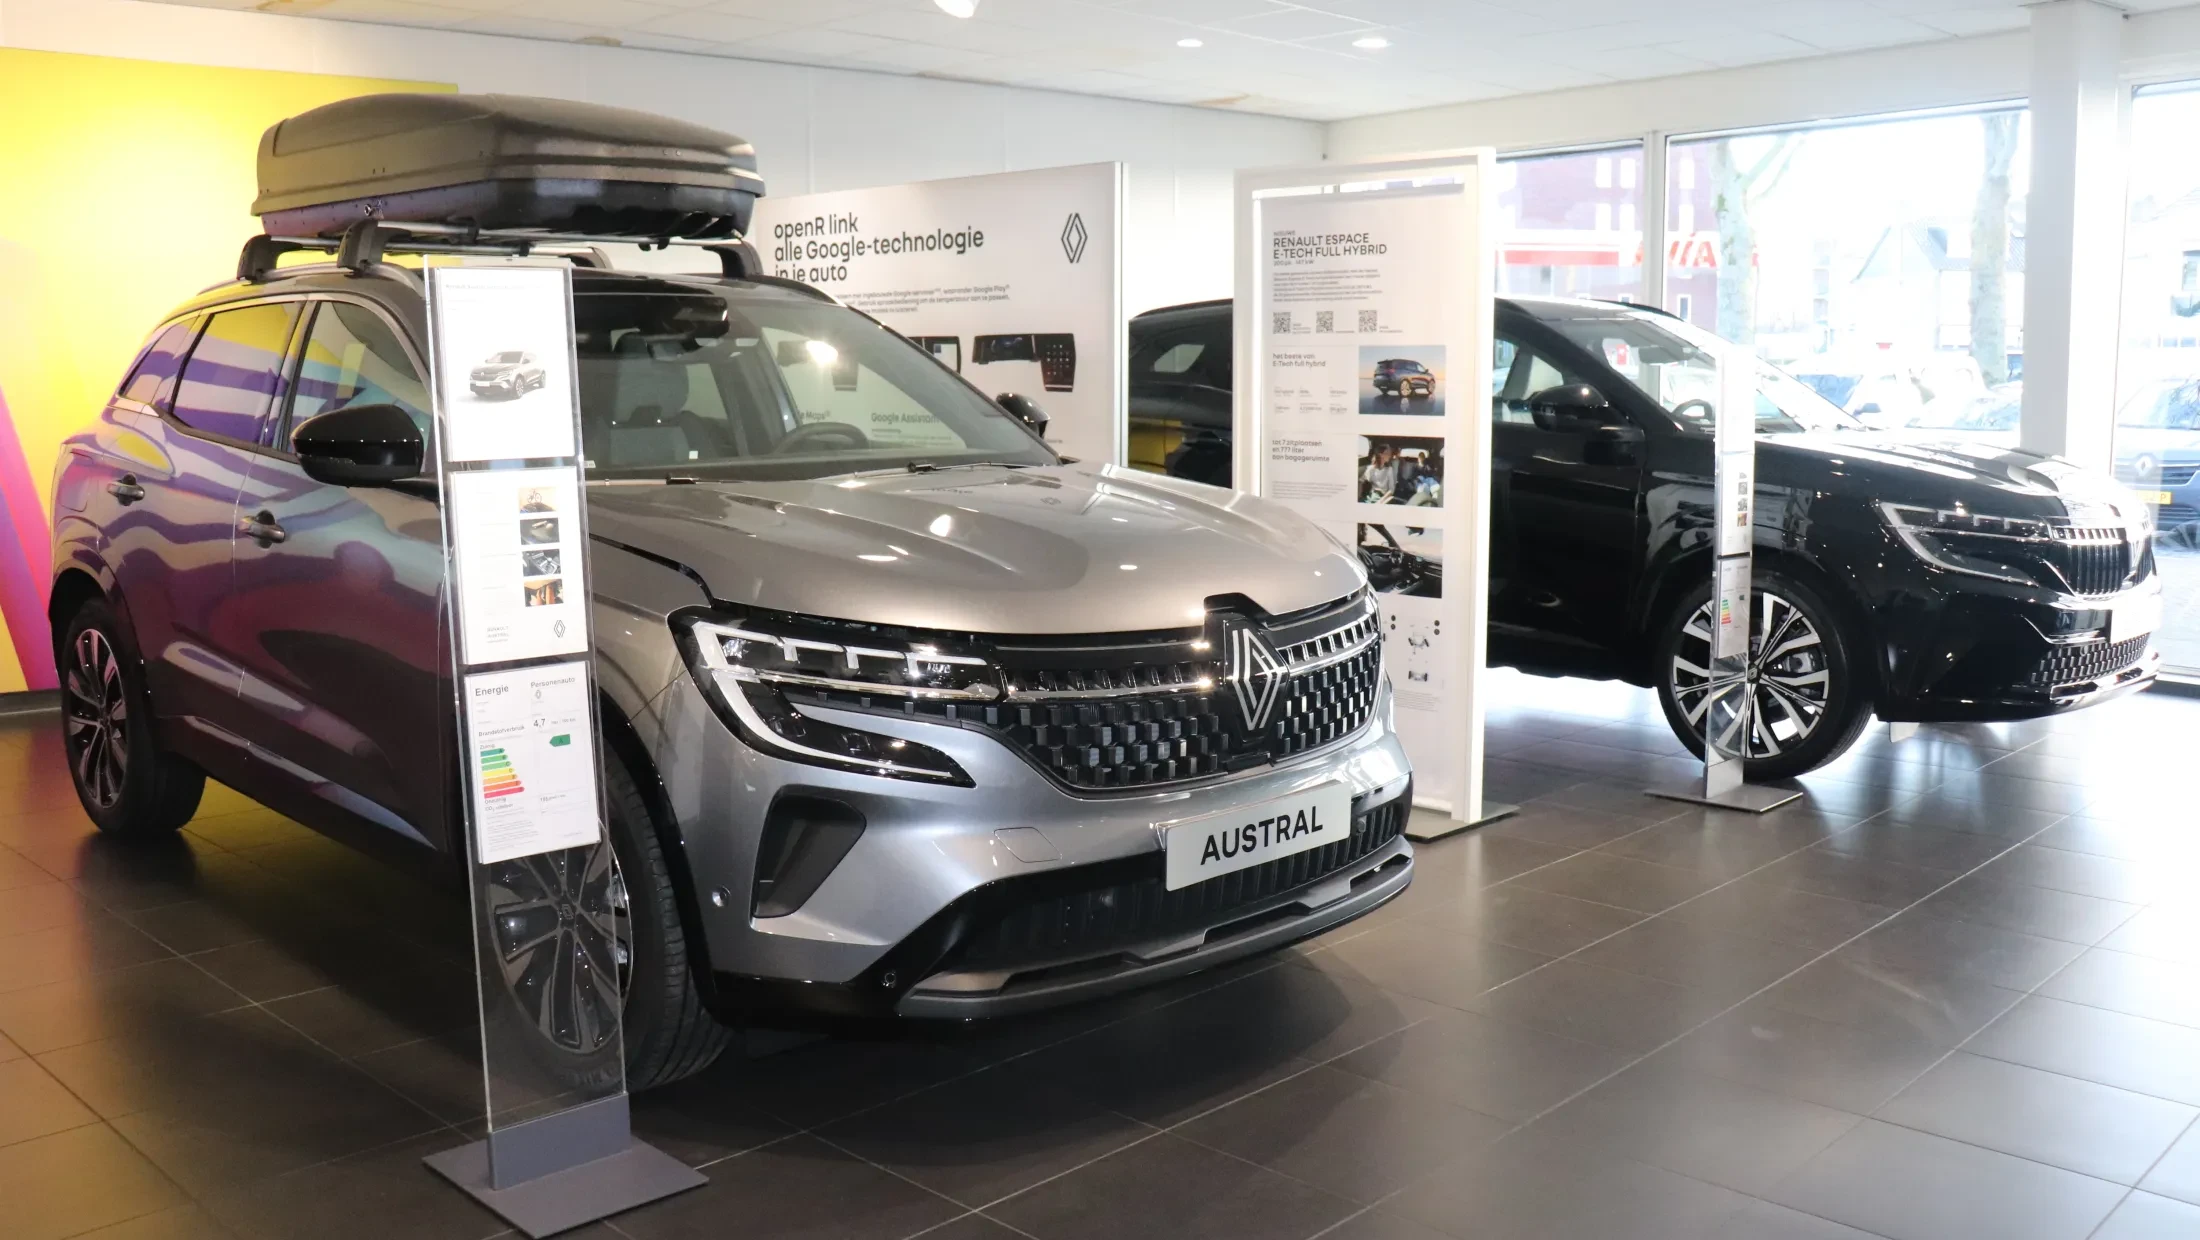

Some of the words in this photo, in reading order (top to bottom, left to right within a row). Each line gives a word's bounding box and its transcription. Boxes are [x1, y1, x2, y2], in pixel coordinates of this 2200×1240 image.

[774, 217, 825, 240] openR
[829, 212, 859, 234] link
[775, 236, 801, 261] alle
[806, 226, 984, 262] Google-technologie
[1273, 235, 1323, 248] RENAULT
[1325, 233, 1369, 245] ESPACE
[1273, 247, 1313, 259] E-TECH
[1315, 246, 1341, 257] FULL
[1343, 244, 1387, 255] HYBRID
[810, 264, 848, 282] auto
[871, 411, 898, 425] Google
[530, 677, 576, 688] Personenauto
[475, 684, 509, 697] Energie
[533, 718, 546, 728] 4,7
[1200, 806, 1324, 866] AUSTRAL
